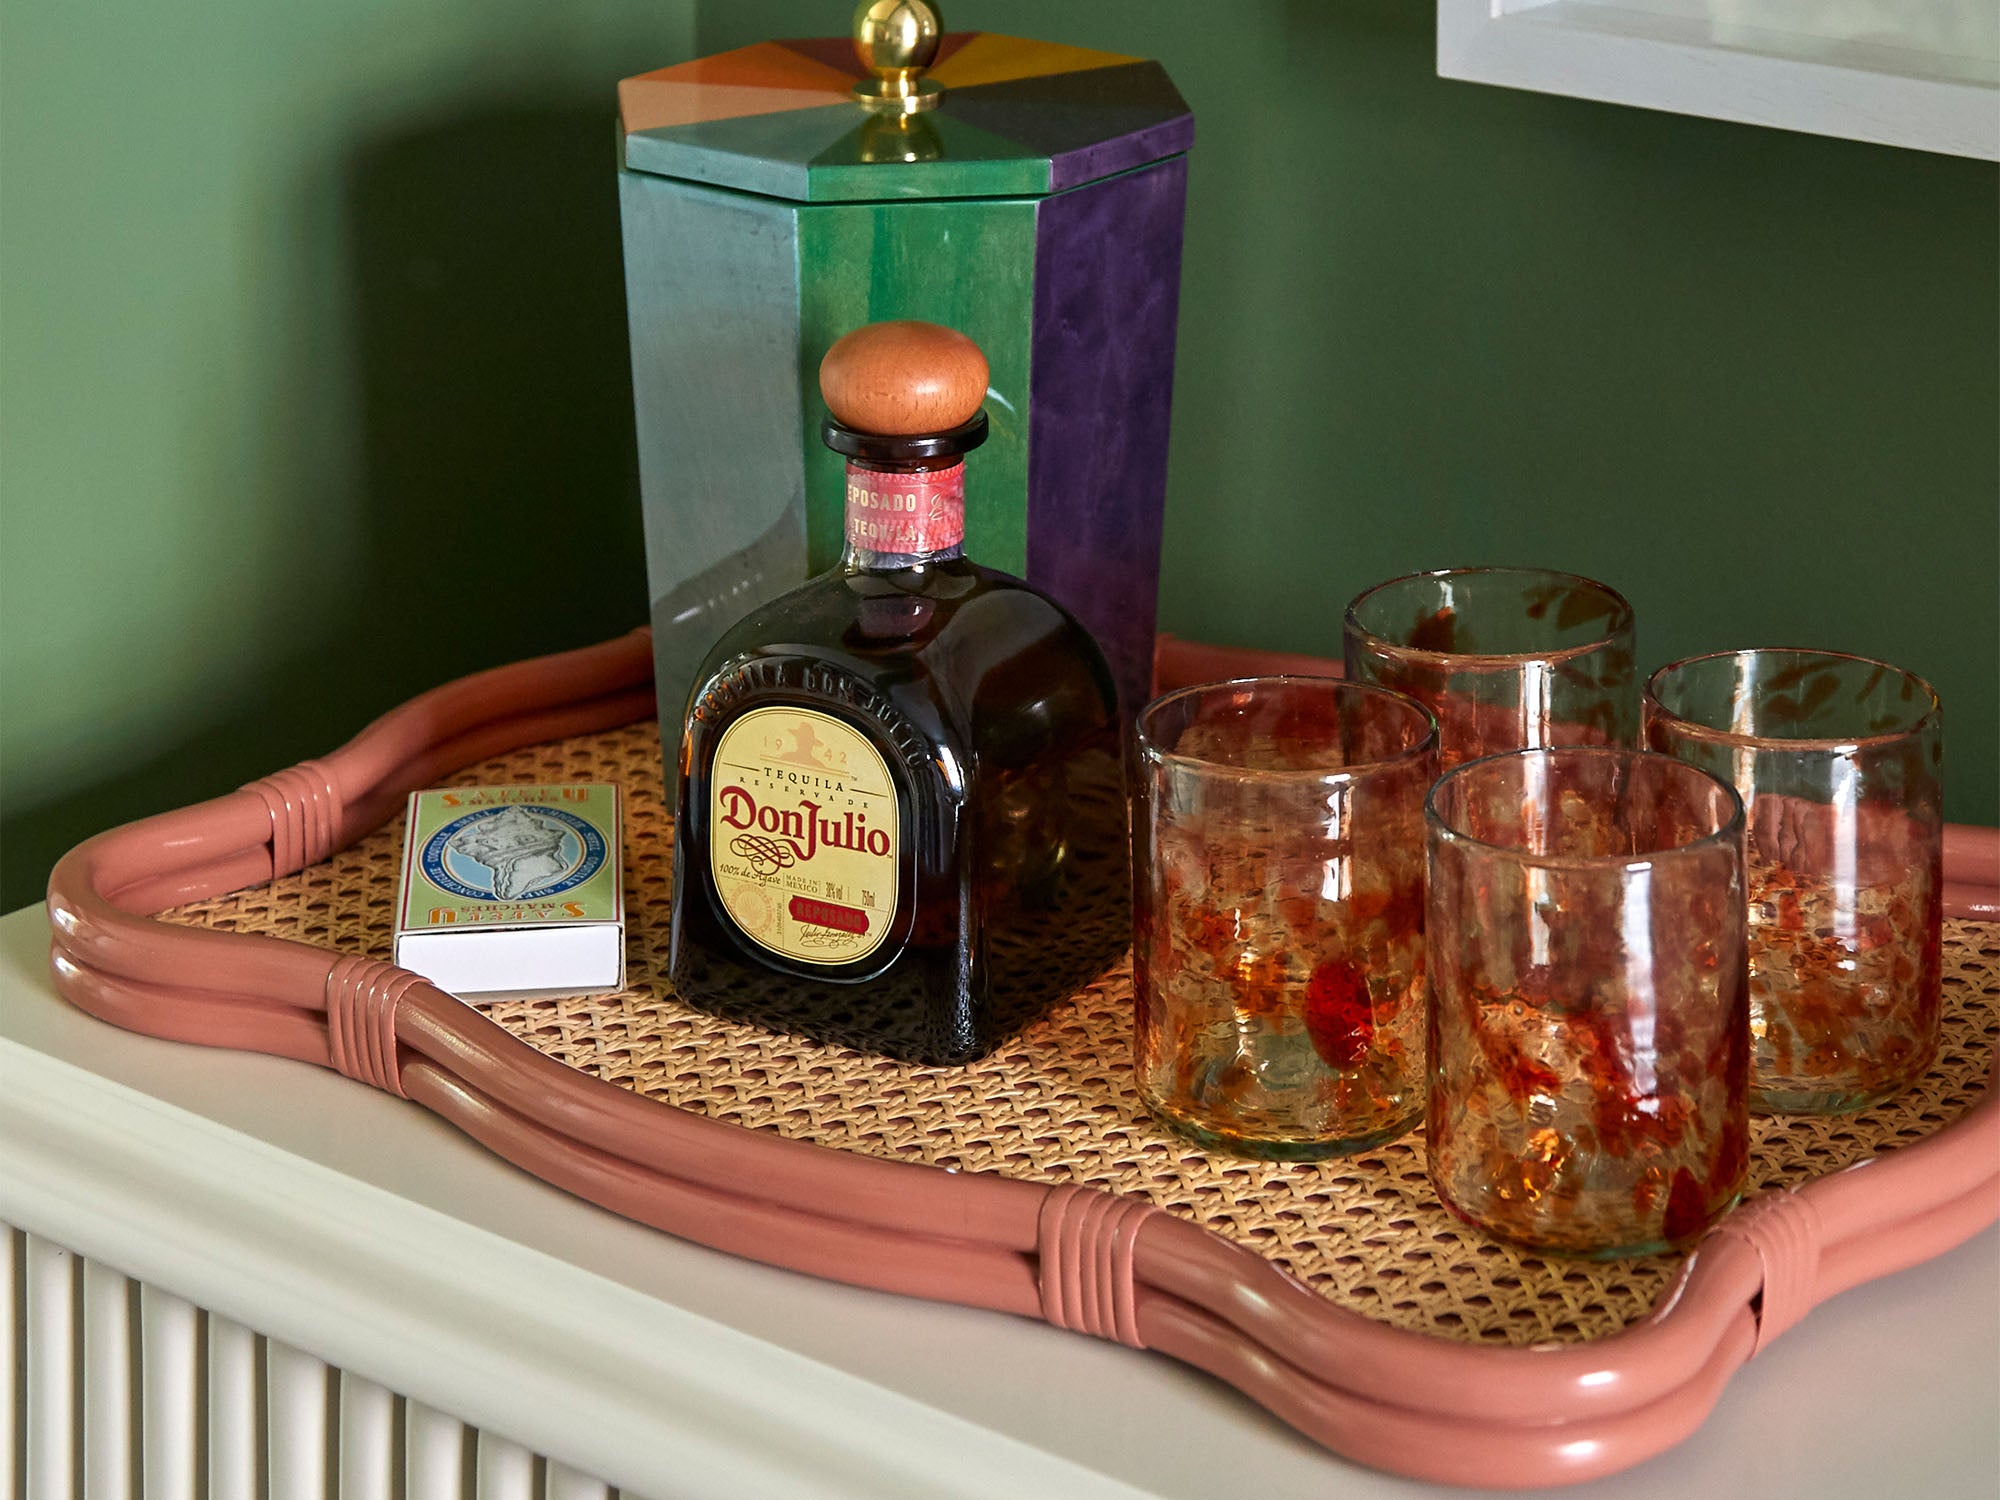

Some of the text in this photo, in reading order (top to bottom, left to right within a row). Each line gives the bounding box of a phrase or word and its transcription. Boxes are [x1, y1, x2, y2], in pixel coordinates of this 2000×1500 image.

[847, 483, 917, 513] EPOSADO
[853, 518, 918, 543] TEQUILA
[763, 766, 845, 793] TEQUILA
[739, 776, 869, 809] RESERVA DE
[719, 863, 782, 887] 100% de Agave
[786, 874, 807, 884] MADE
[786, 881, 818, 894] MEXICO
[460, 902, 556, 914] MATCHES
[796, 901, 862, 928] REPOSADO
